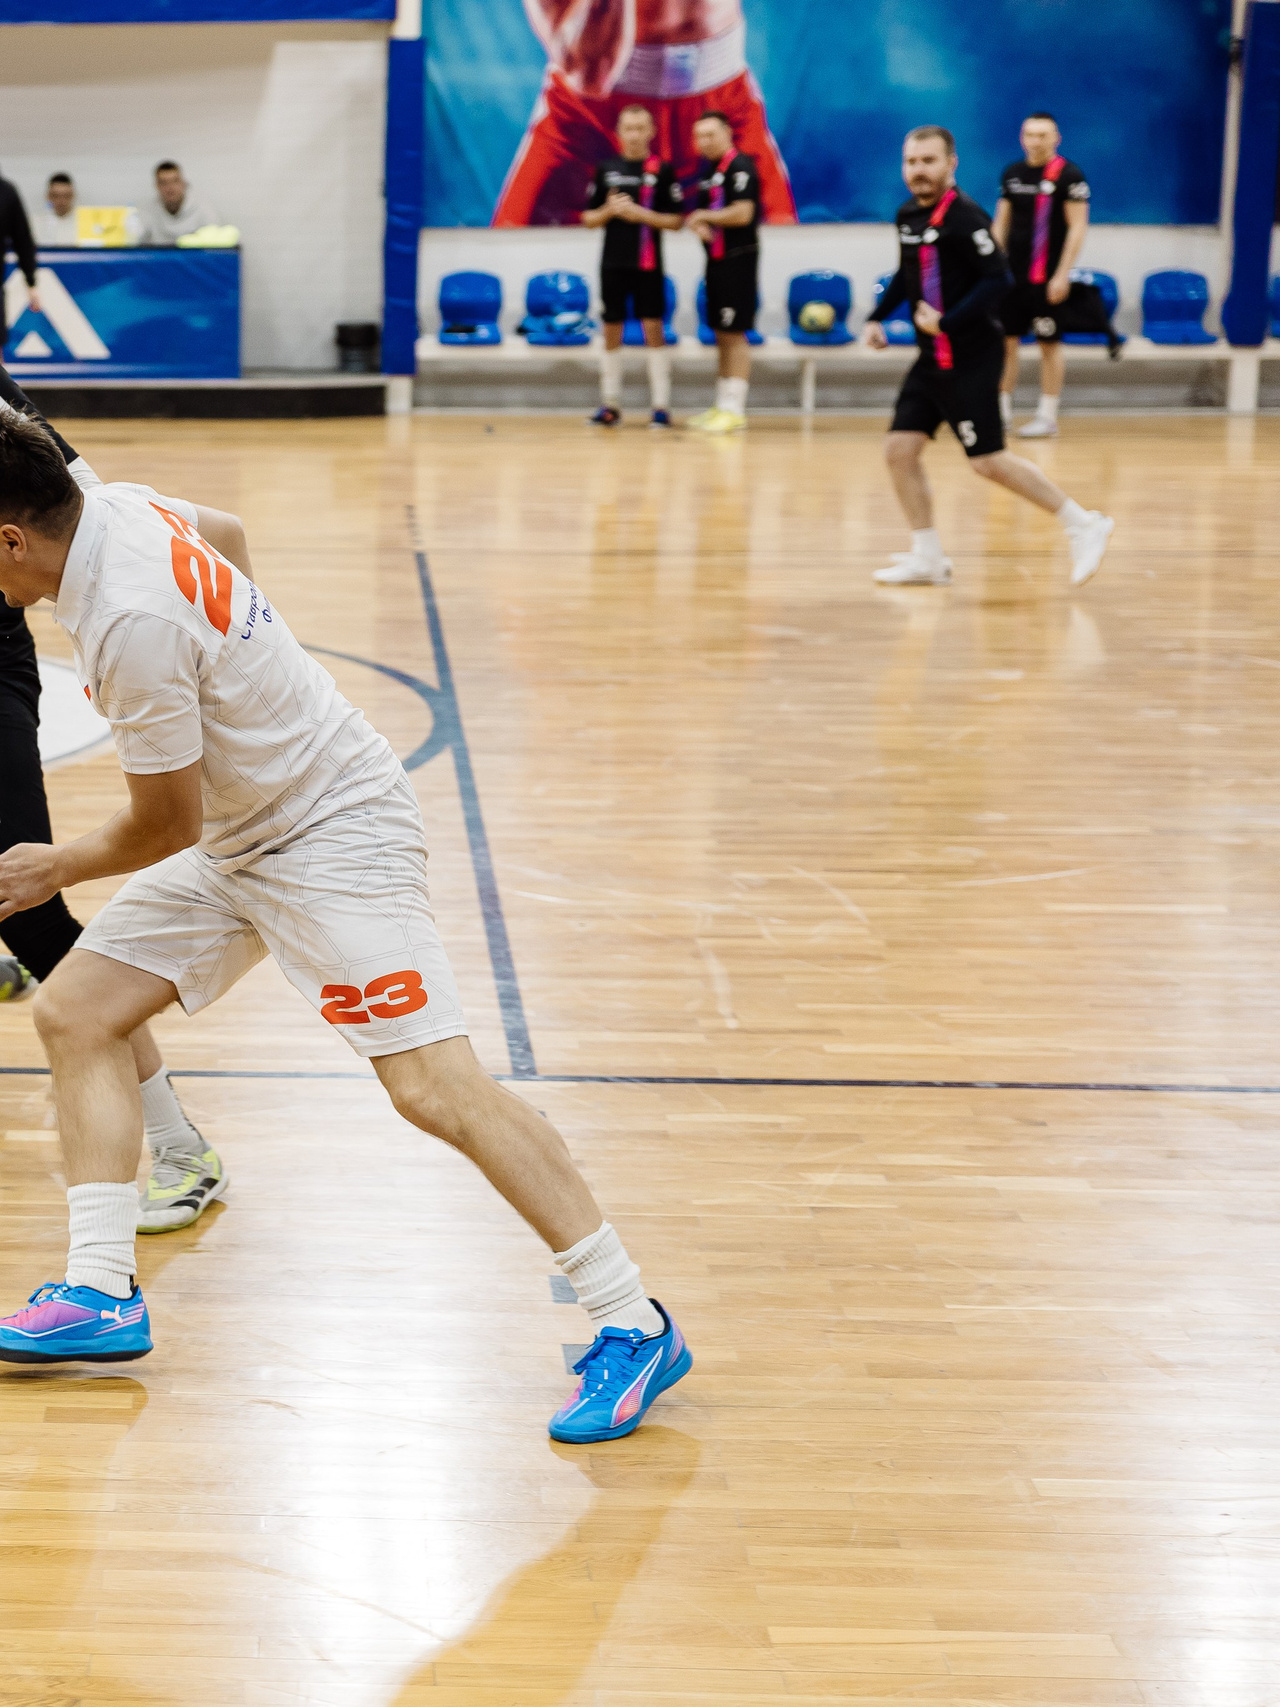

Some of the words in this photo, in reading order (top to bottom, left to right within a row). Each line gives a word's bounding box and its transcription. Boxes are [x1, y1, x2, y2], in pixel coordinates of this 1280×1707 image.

[972, 228, 995, 255] 5
[958, 420, 978, 447] 5
[320, 970, 428, 1024] 23
